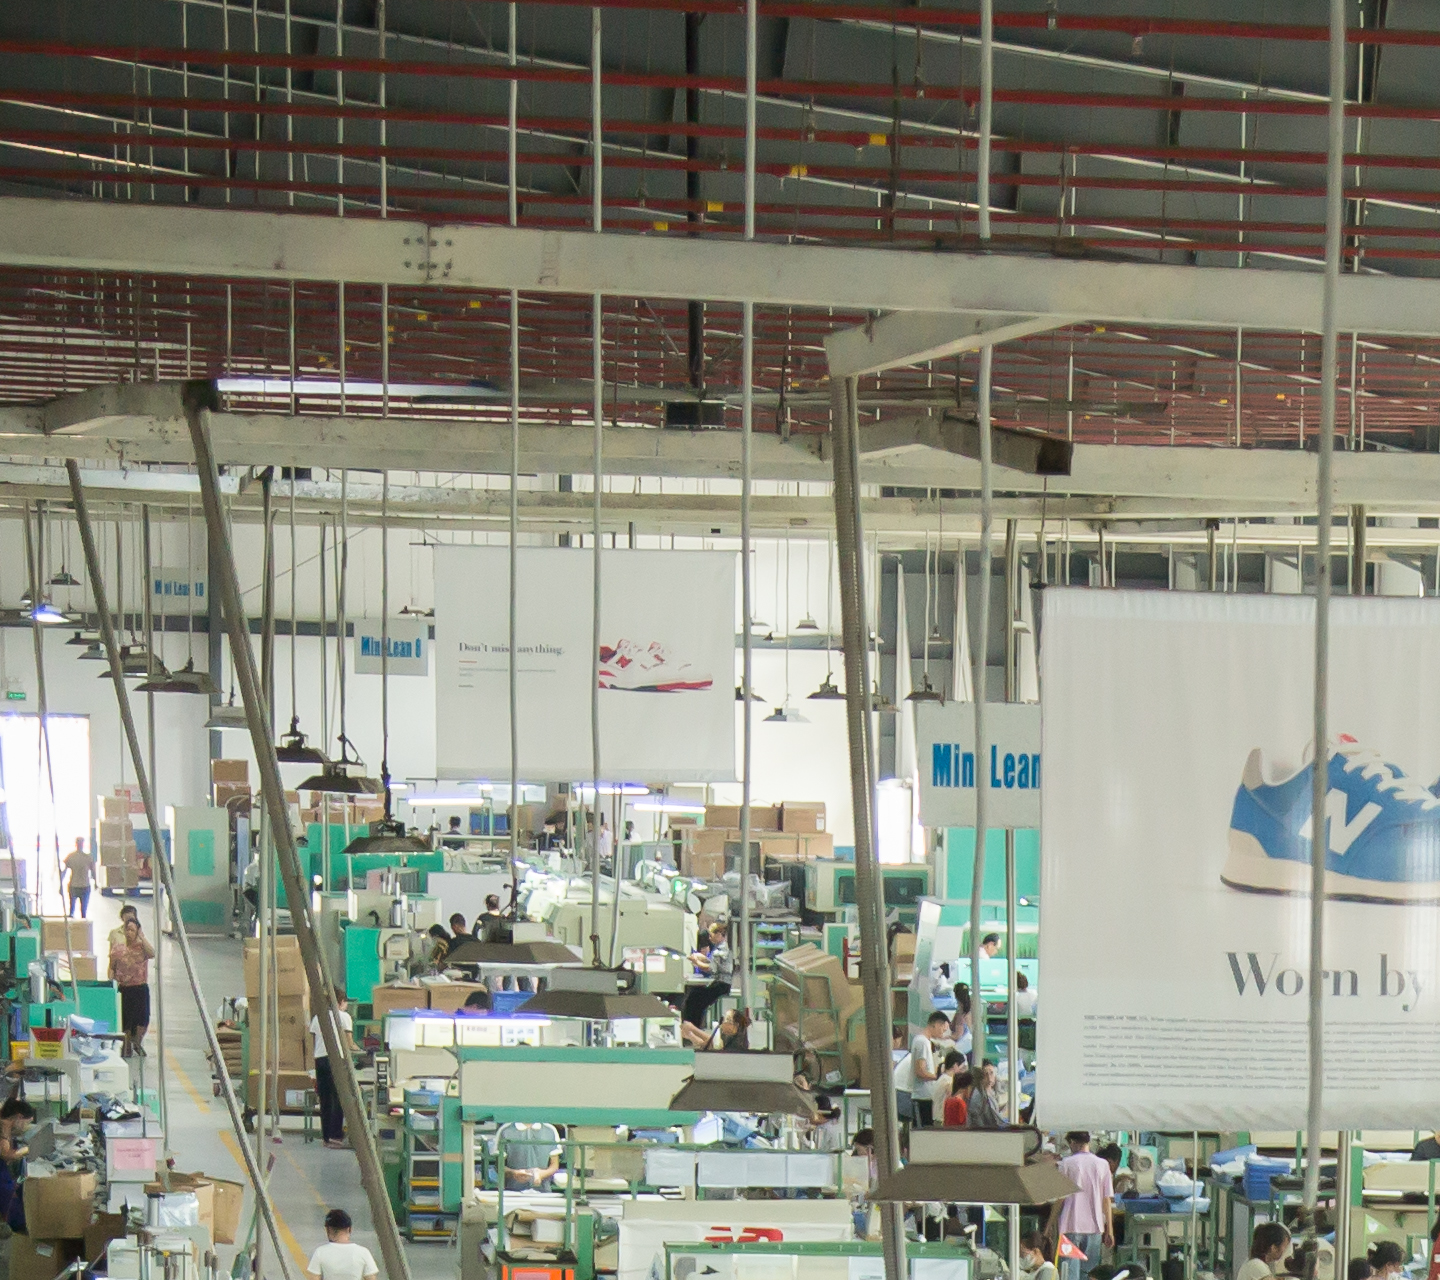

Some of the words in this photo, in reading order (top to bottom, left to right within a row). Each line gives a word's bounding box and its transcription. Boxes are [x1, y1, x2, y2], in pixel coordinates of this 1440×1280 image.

[361, 636, 383, 656] Min
[491, 644, 511, 653] mis
[932, 743, 975, 788] Min
[1377, 951, 1424, 1013] by
